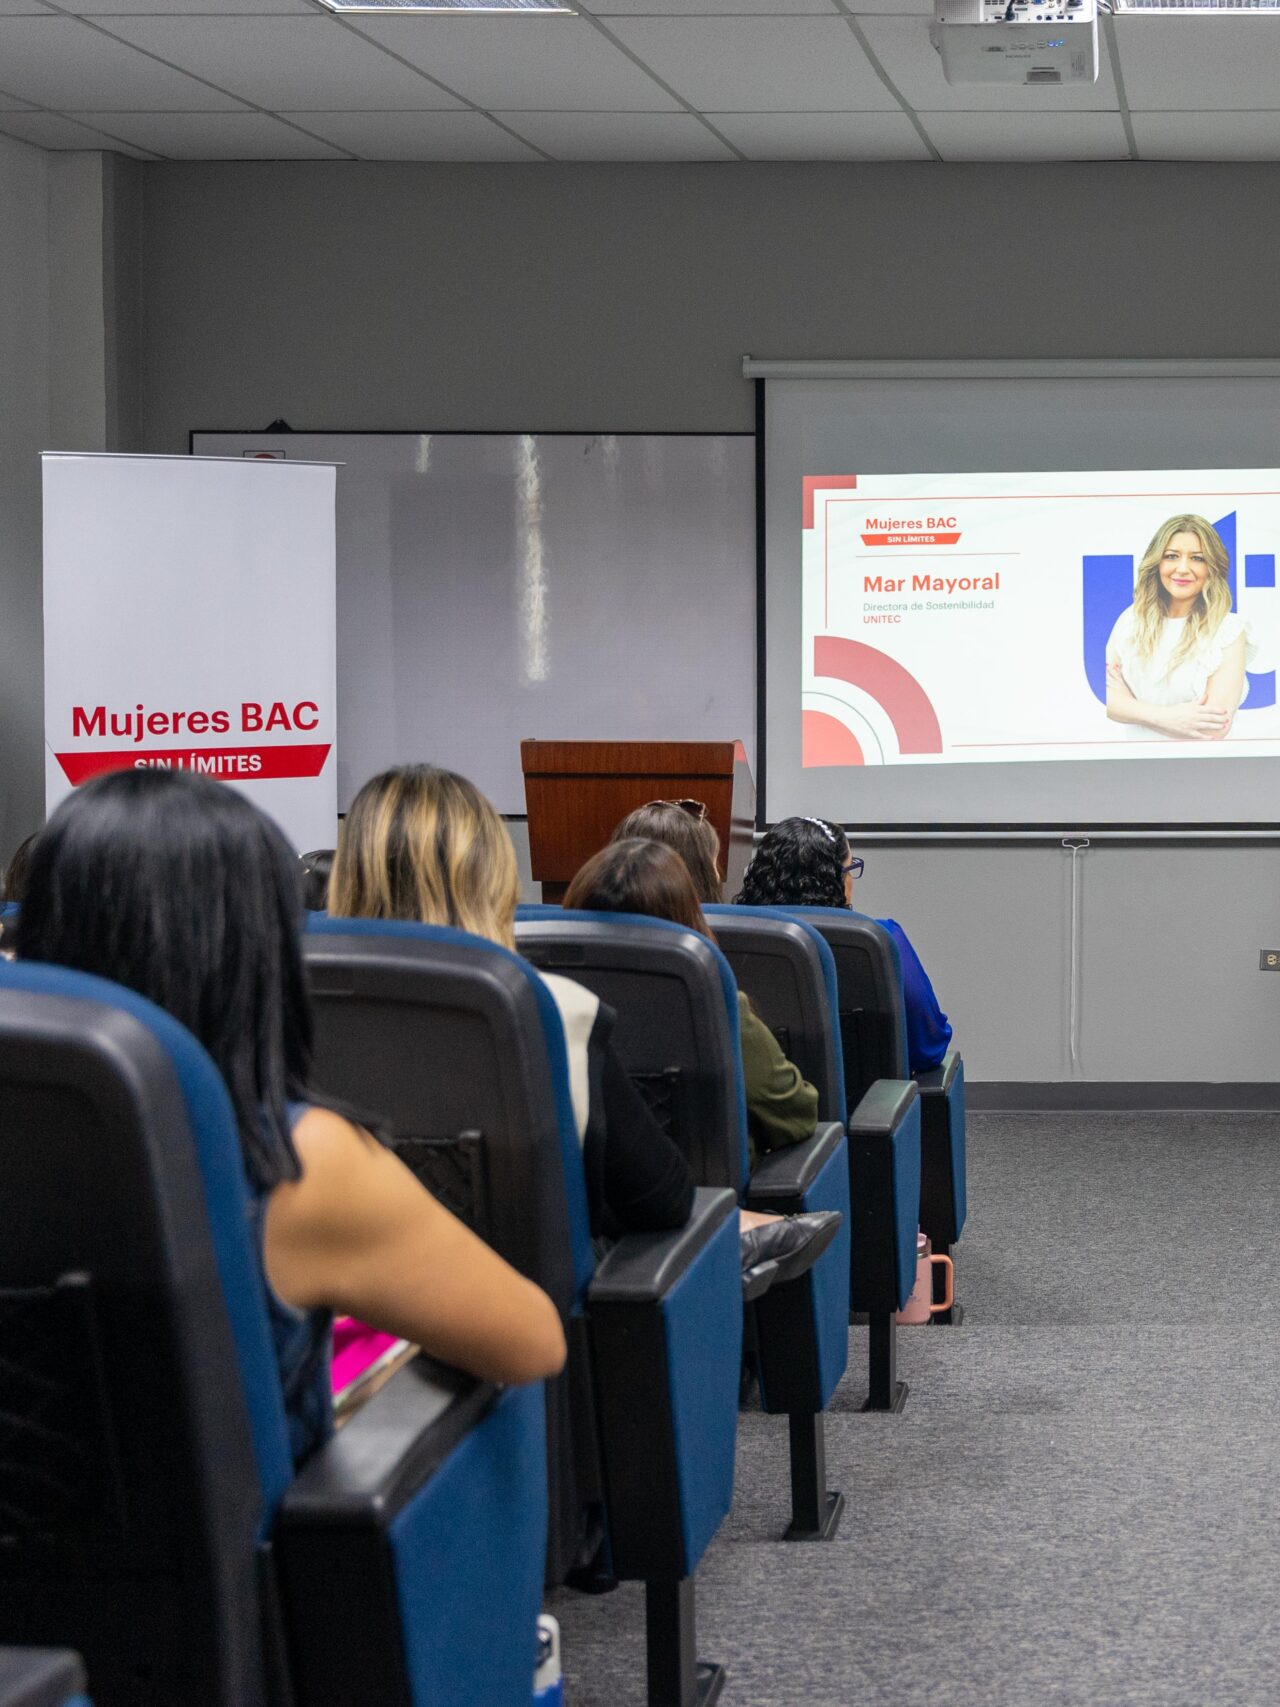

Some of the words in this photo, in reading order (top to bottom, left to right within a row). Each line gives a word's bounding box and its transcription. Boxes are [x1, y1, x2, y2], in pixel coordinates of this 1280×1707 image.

[865, 518, 923, 531] Mujeres
[926, 516, 957, 529] BAC
[863, 575, 906, 593] Mar
[912, 572, 1000, 594] Mayoral
[863, 602, 908, 612] Directora
[910, 601, 923, 611] de
[926, 600, 995, 610] Sostenibilidad
[863, 614, 902, 624] UNITEC
[72, 704, 230, 742] Mujeres
[241, 701, 320, 733] BAC
